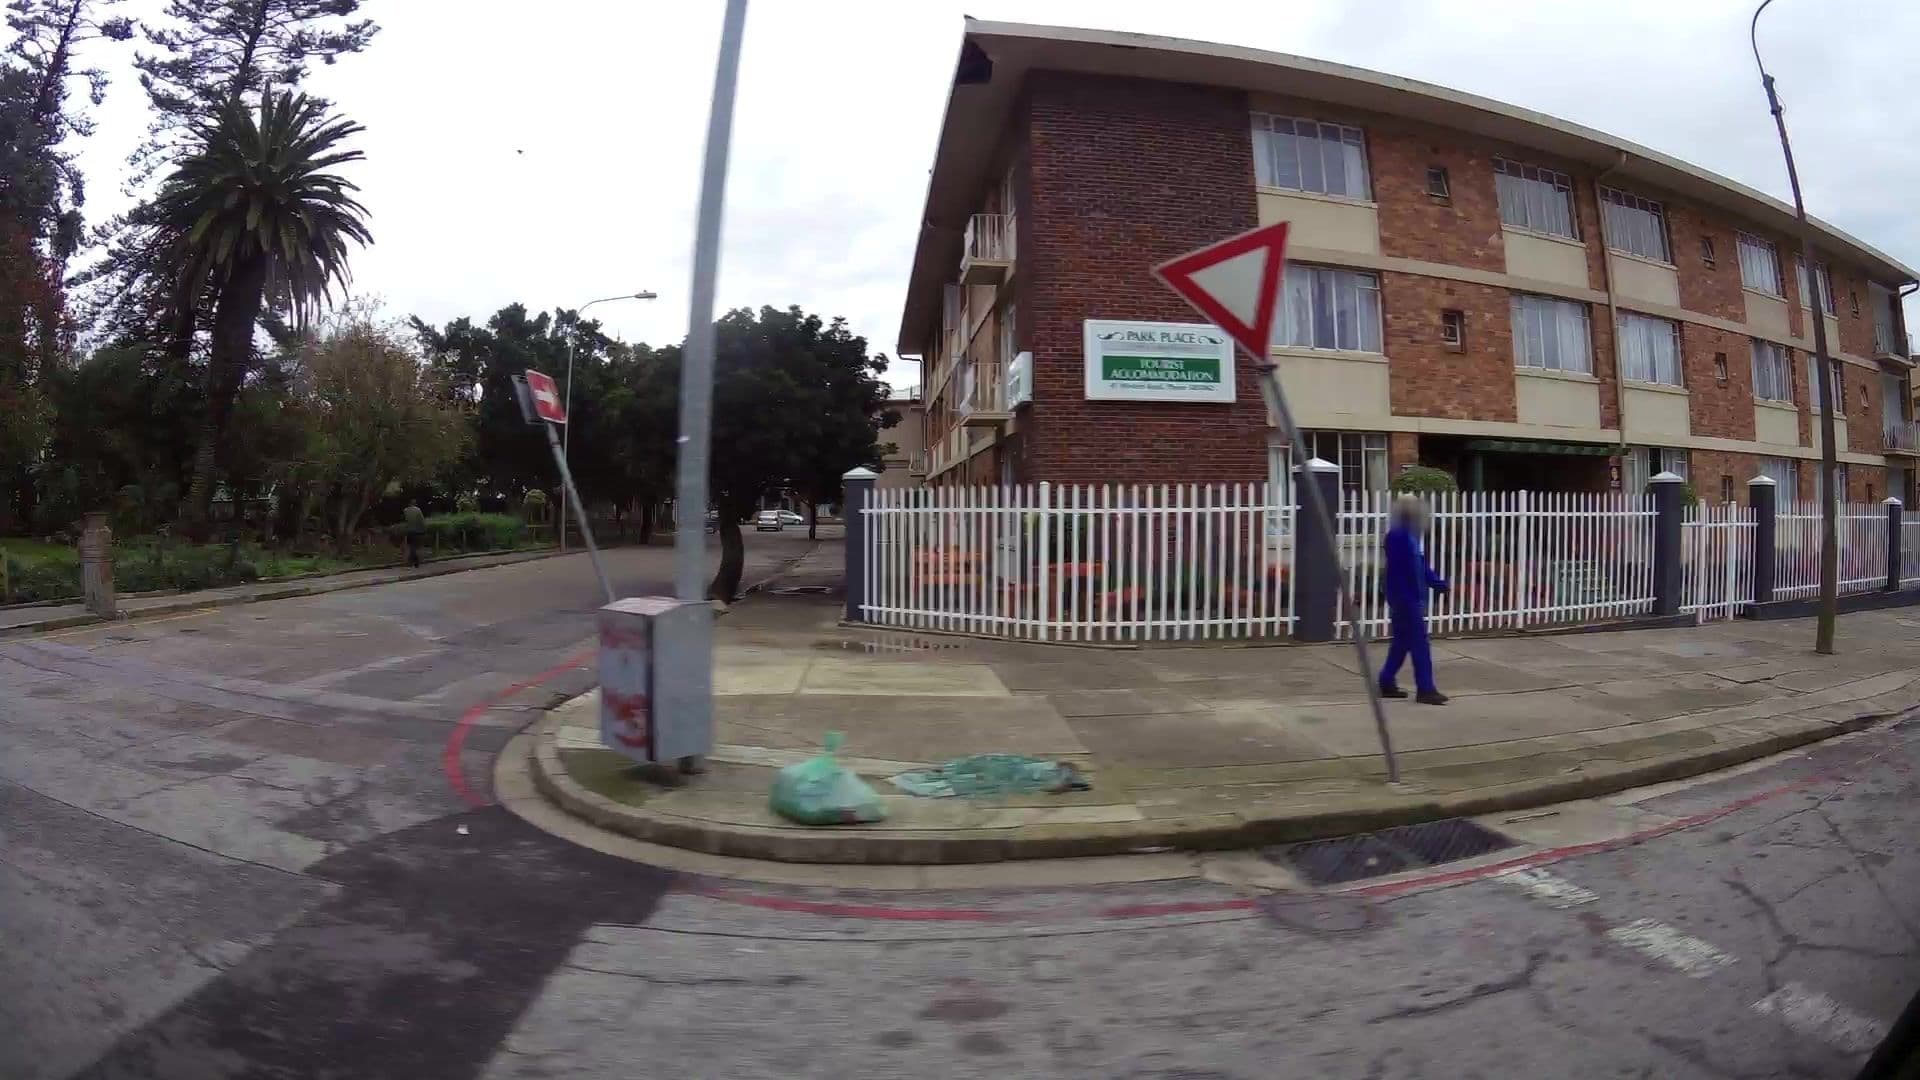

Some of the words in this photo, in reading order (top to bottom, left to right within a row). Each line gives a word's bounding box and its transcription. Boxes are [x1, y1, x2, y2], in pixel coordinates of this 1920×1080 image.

[1127, 331, 1155, 341] PARK
[1160, 332, 1196, 343] PLACE
[1140, 360, 1184, 369] TOURIST
[1111, 369, 1214, 380] ACCOMMODATION
